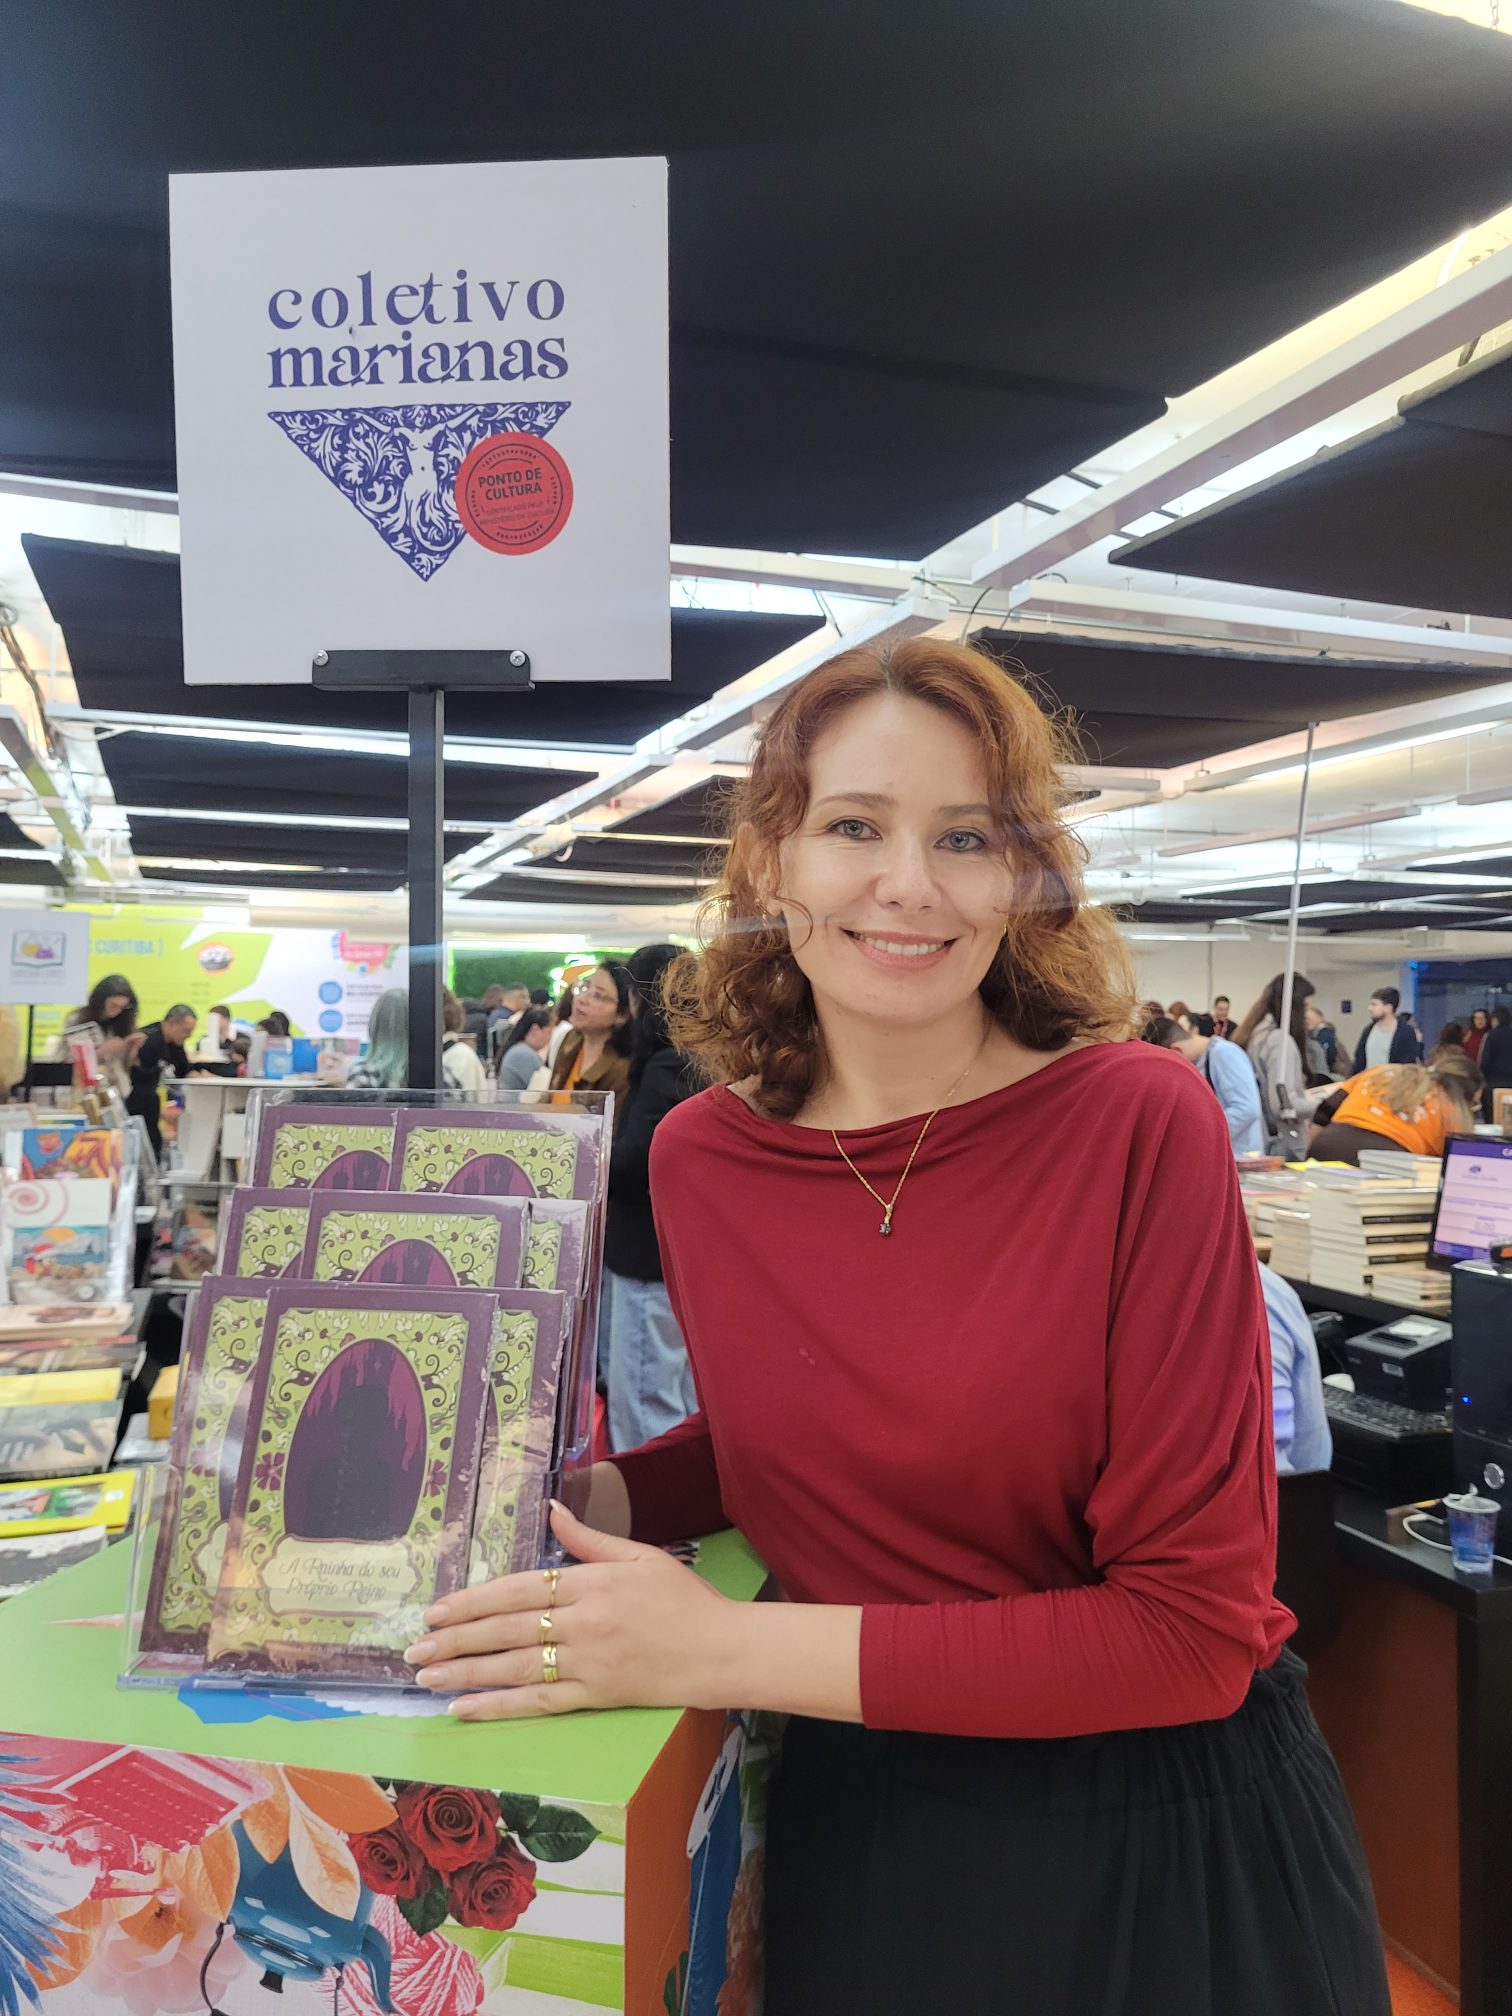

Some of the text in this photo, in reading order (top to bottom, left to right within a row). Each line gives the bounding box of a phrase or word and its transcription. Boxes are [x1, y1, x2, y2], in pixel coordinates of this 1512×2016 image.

[268, 269, 565, 329] coletivo
[267, 330, 568, 388] marianas
[478, 467, 542, 488] PONTO DE
[485, 482, 542, 501] CULTURA
[280, 1557, 401, 1582] A Rainha do seu
[286, 1578, 387, 1605] Próprio Reino
